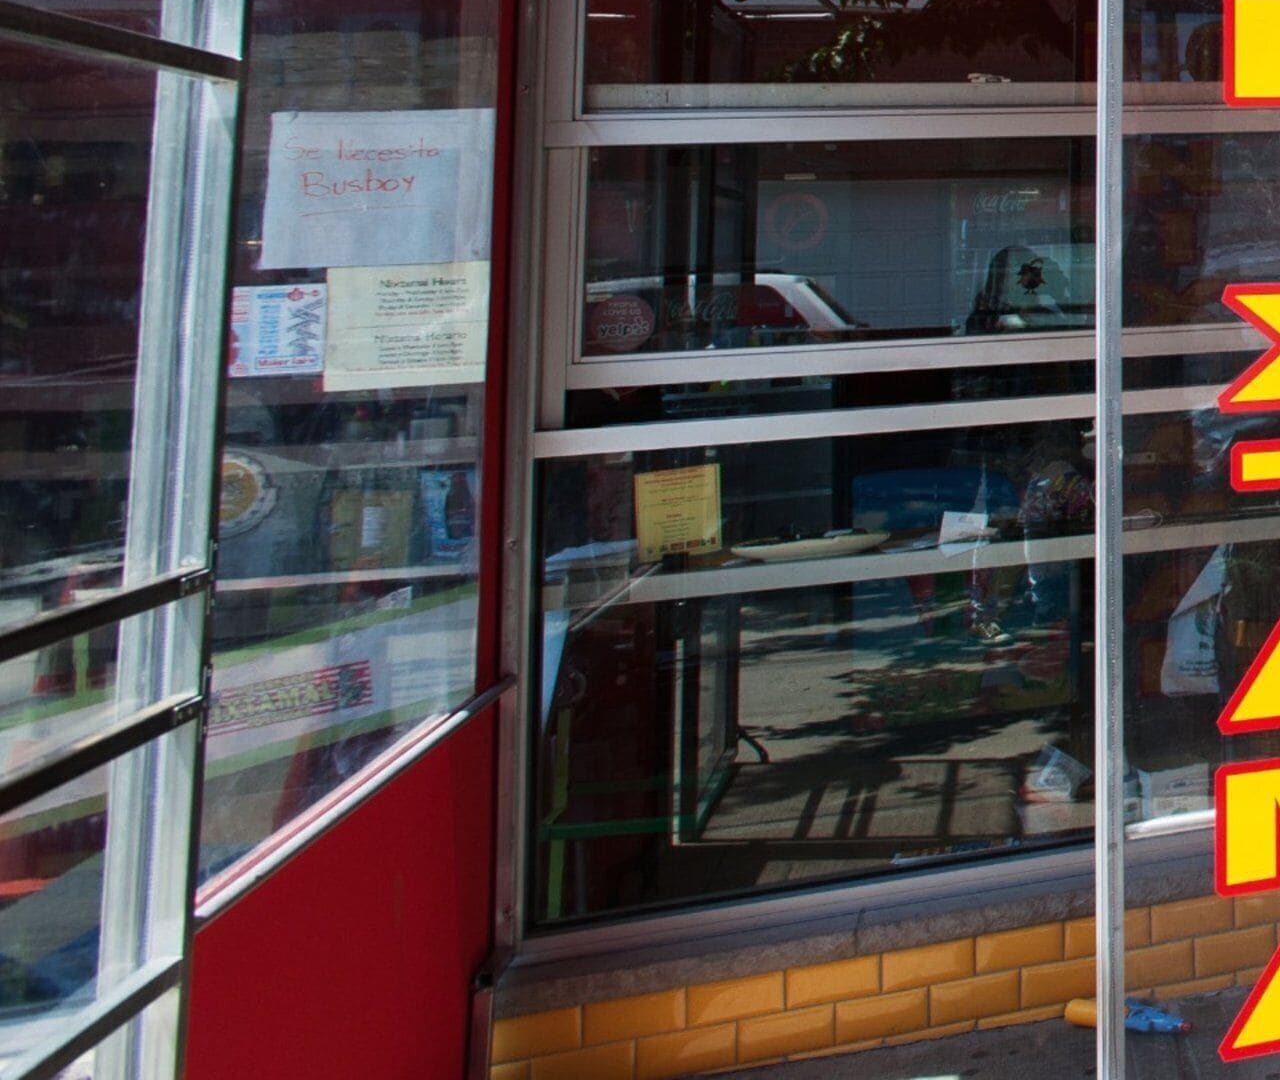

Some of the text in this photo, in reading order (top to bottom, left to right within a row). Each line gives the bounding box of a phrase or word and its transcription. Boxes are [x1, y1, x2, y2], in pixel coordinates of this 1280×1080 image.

[283, 136, 321, 162] Se
[300, 169, 415, 197] Busboy
[600, 322, 632, 337] yelp
